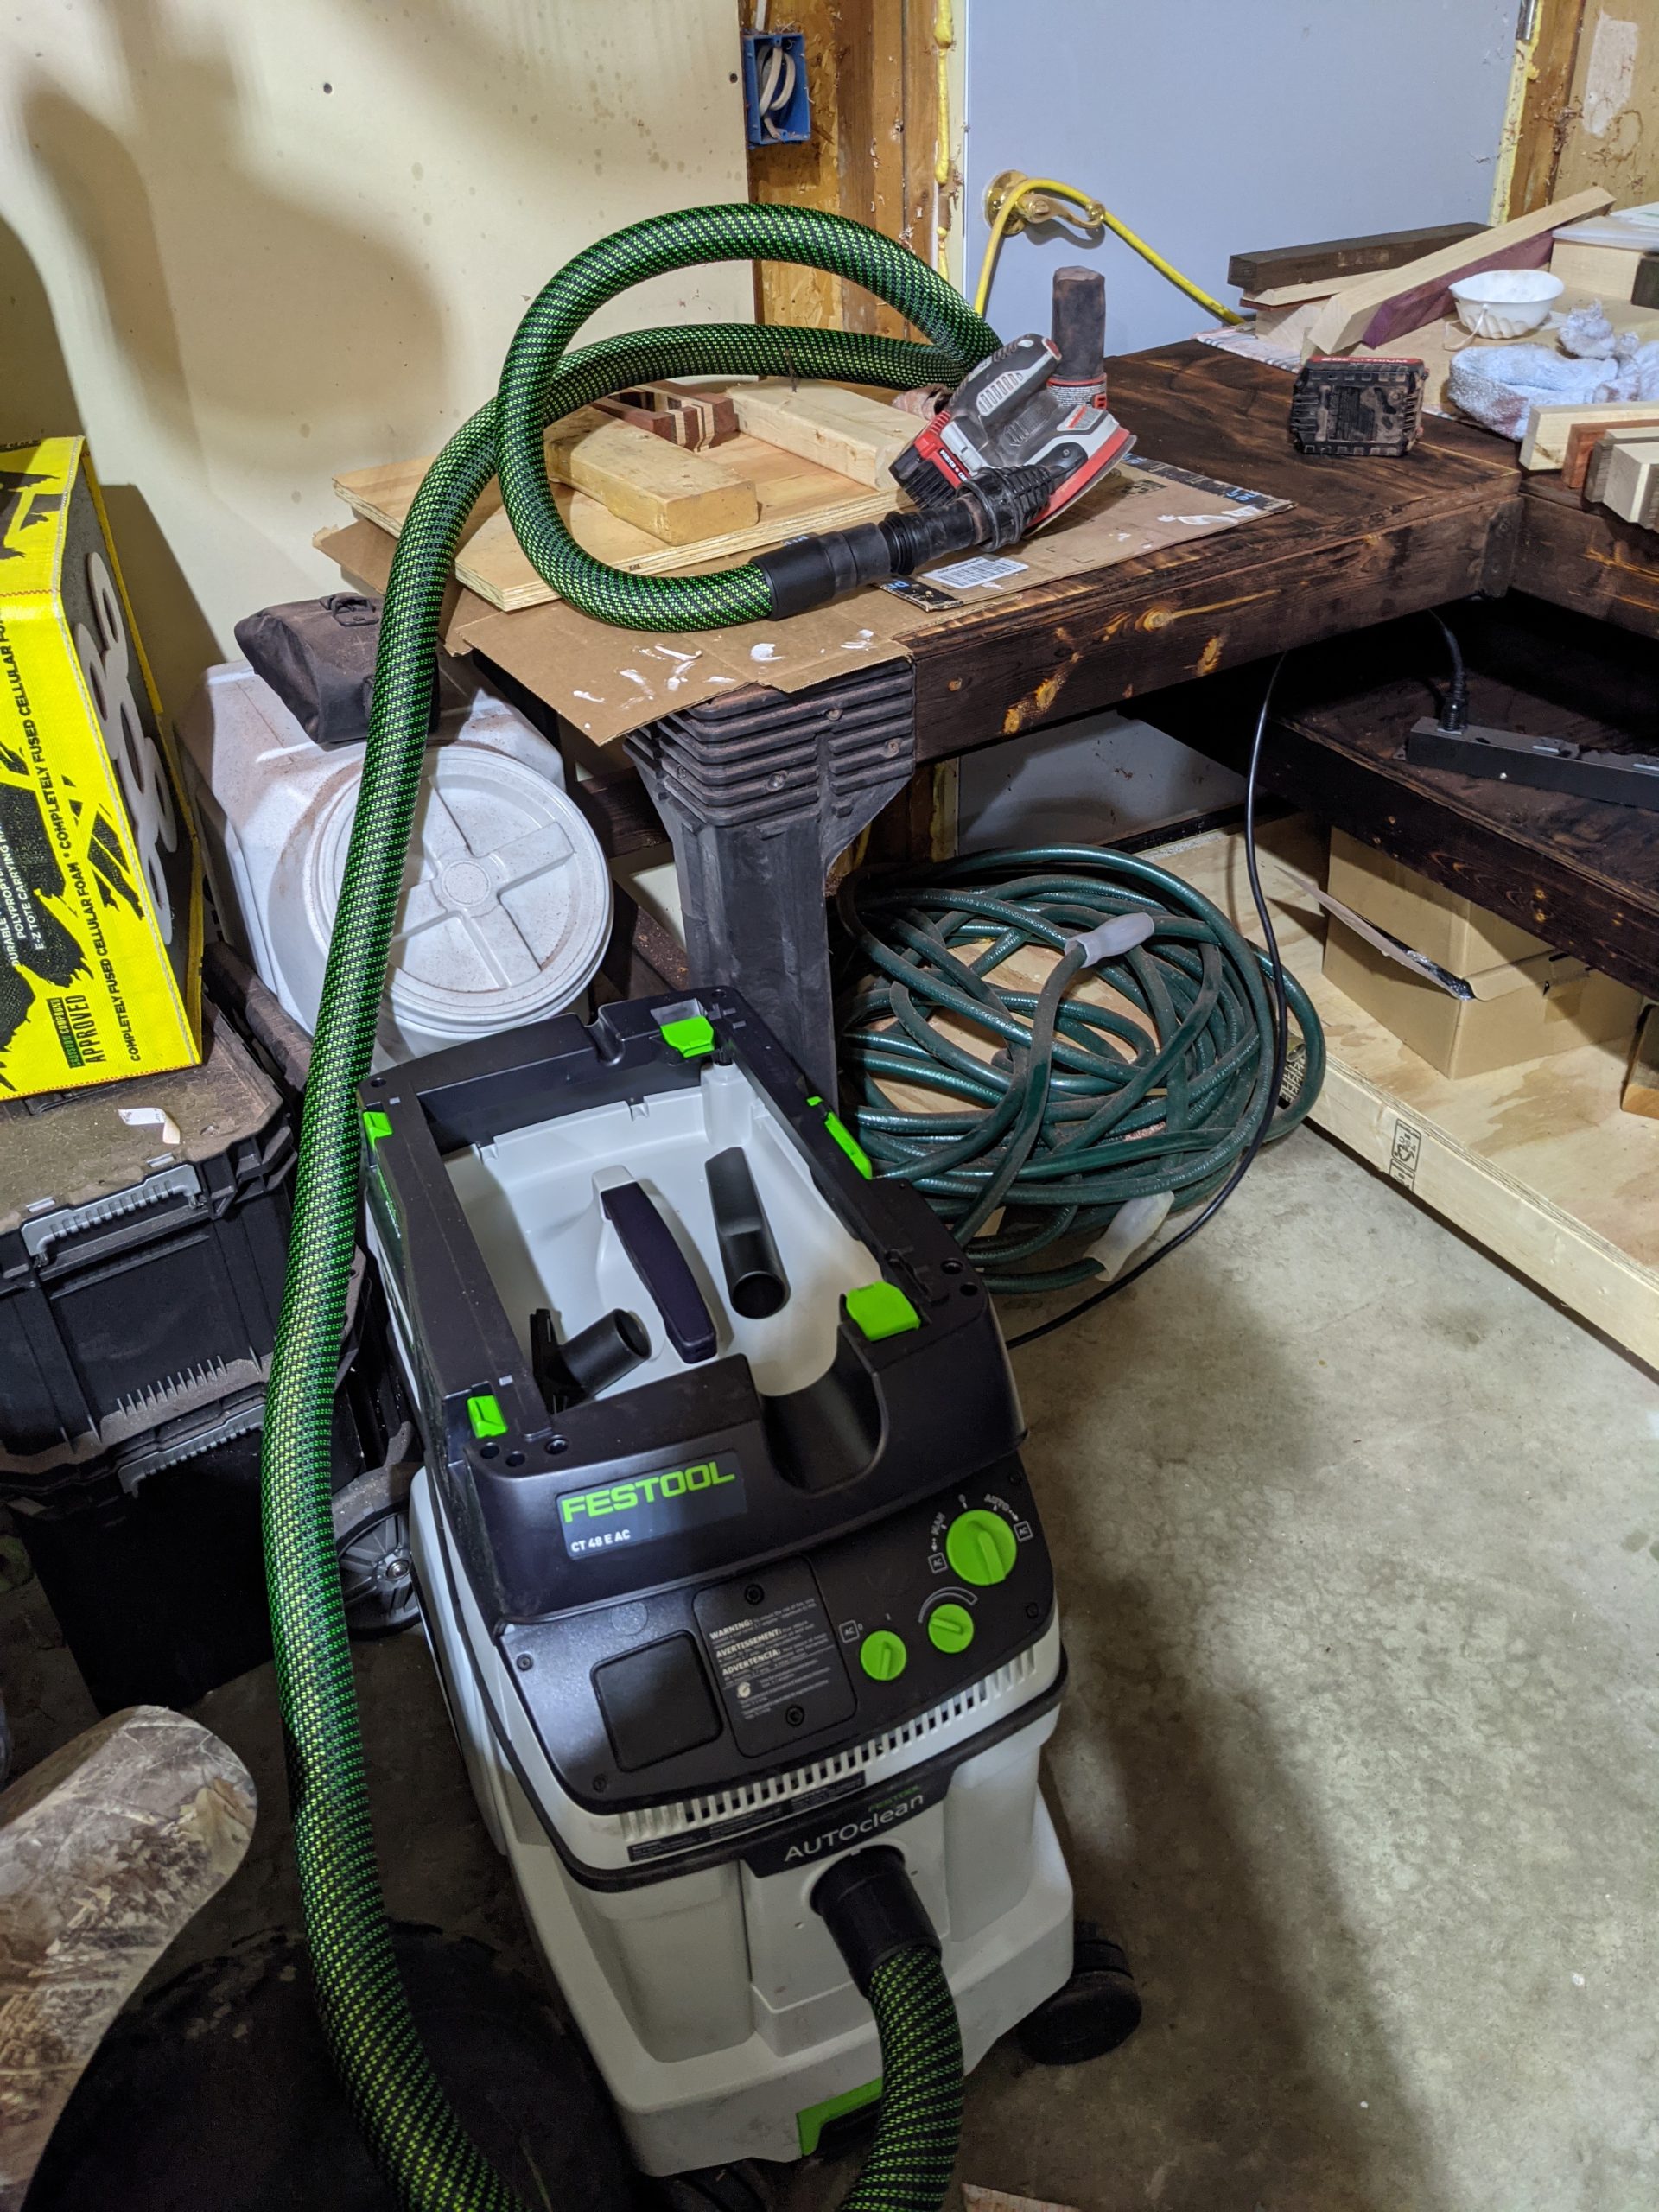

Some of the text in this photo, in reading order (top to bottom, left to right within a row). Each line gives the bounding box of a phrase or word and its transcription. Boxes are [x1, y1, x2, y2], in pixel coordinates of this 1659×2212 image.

[0, 645, 72, 850] COMPLETELY FUSED CELLULAR
[0, 844, 28, 900] CARRYING
[22, 902, 38, 931] TOTE
[0, 917, 21, 967] DURABLE
[31, 931, 45, 950] E-Z
[67, 861, 141, 1062] COMPLETELY FUSED CELLULAR FOAM
[50, 999, 70, 1034] COMPOUND
[65, 995, 106, 1064] APPROVED
[561, 1461, 735, 1523] FESTOOL
[570, 1529, 631, 1552] CT 48 E AC
[709, 1618, 753, 1640] WARNING:
[716, 1628, 782, 1658] AVERTISSEMENT:
[722, 1649, 781, 1676] ADVERTENCIA:
[785, 1794, 924, 1862] AUTOclean
